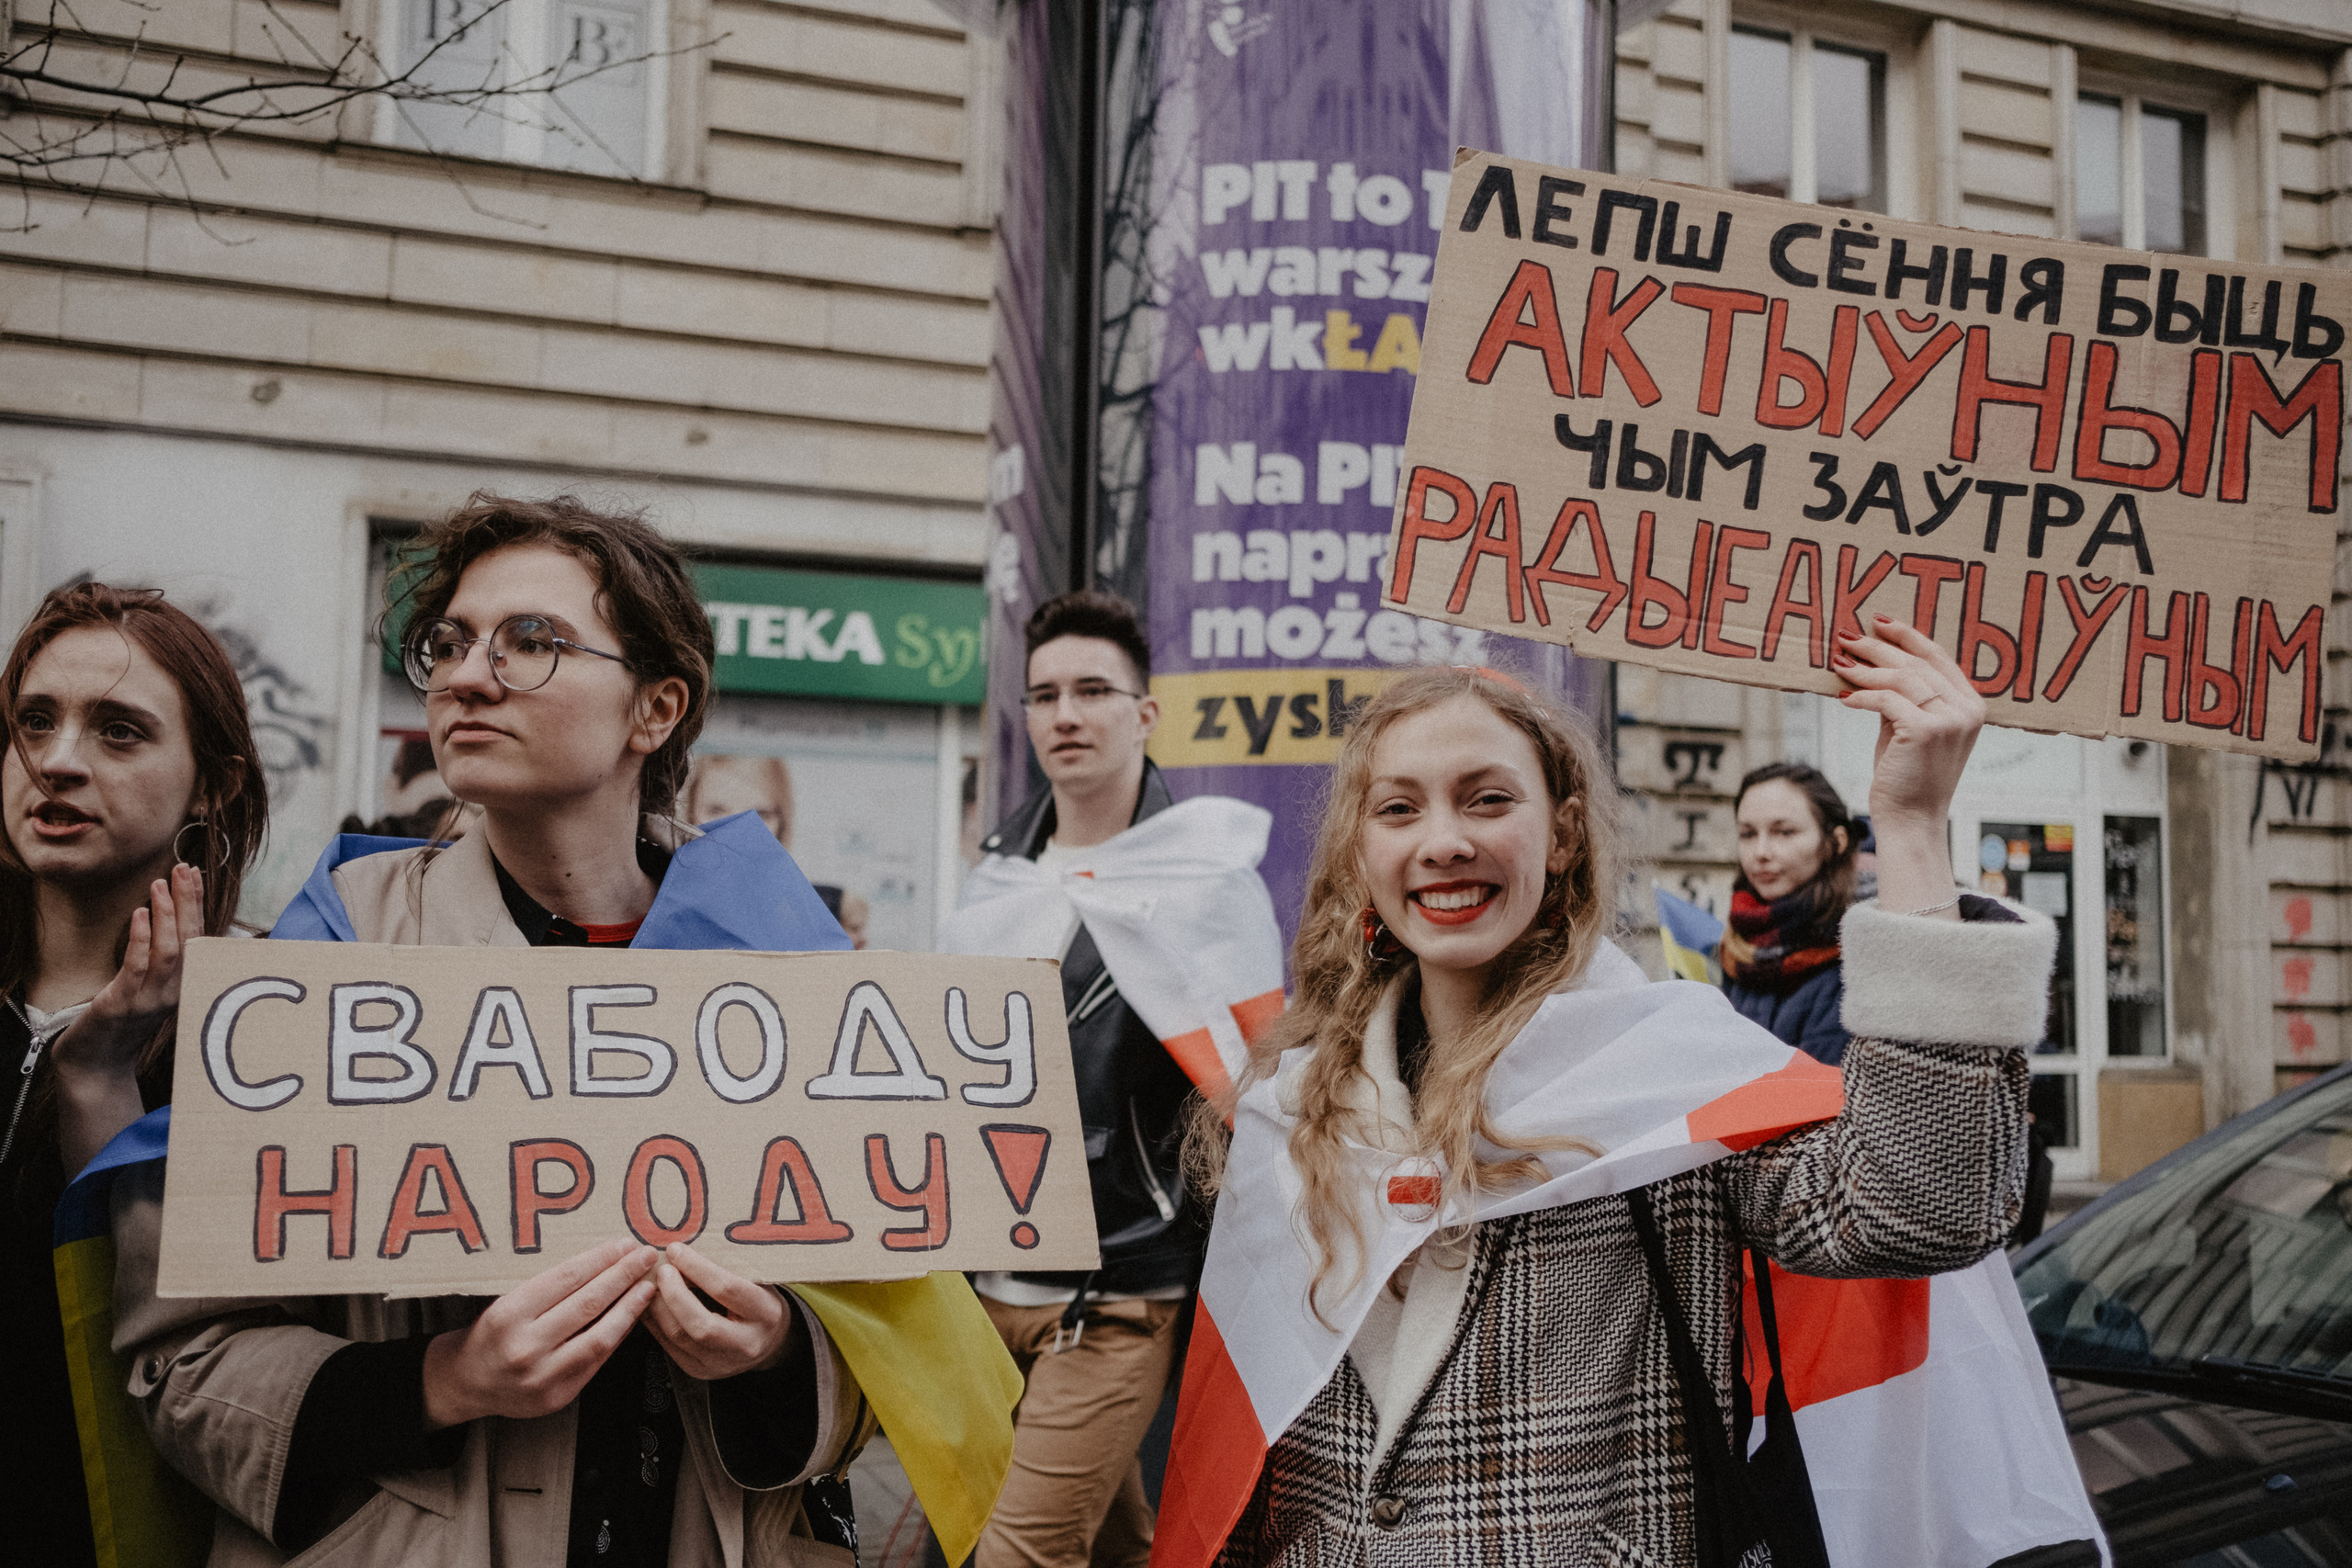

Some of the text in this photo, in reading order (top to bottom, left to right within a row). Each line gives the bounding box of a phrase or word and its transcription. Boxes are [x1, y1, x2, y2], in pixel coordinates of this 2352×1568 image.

[1202, 160, 1317, 225] PIT
[1327, 162, 1413, 226] to
[1459, 165, 2346, 369] ЛЕПШ СЁННЯ БЫЦЬ
[1465, 257, 2344, 514] АКТЫЎНЫМ
[1195, 441, 1305, 506] Na
[1554, 412, 2154, 575] ЧЫМ ЗАЎТРА
[200, 976, 1037, 1110] СВАБОДУ
[252, 1122, 1052, 1263] НАРОДУ!
